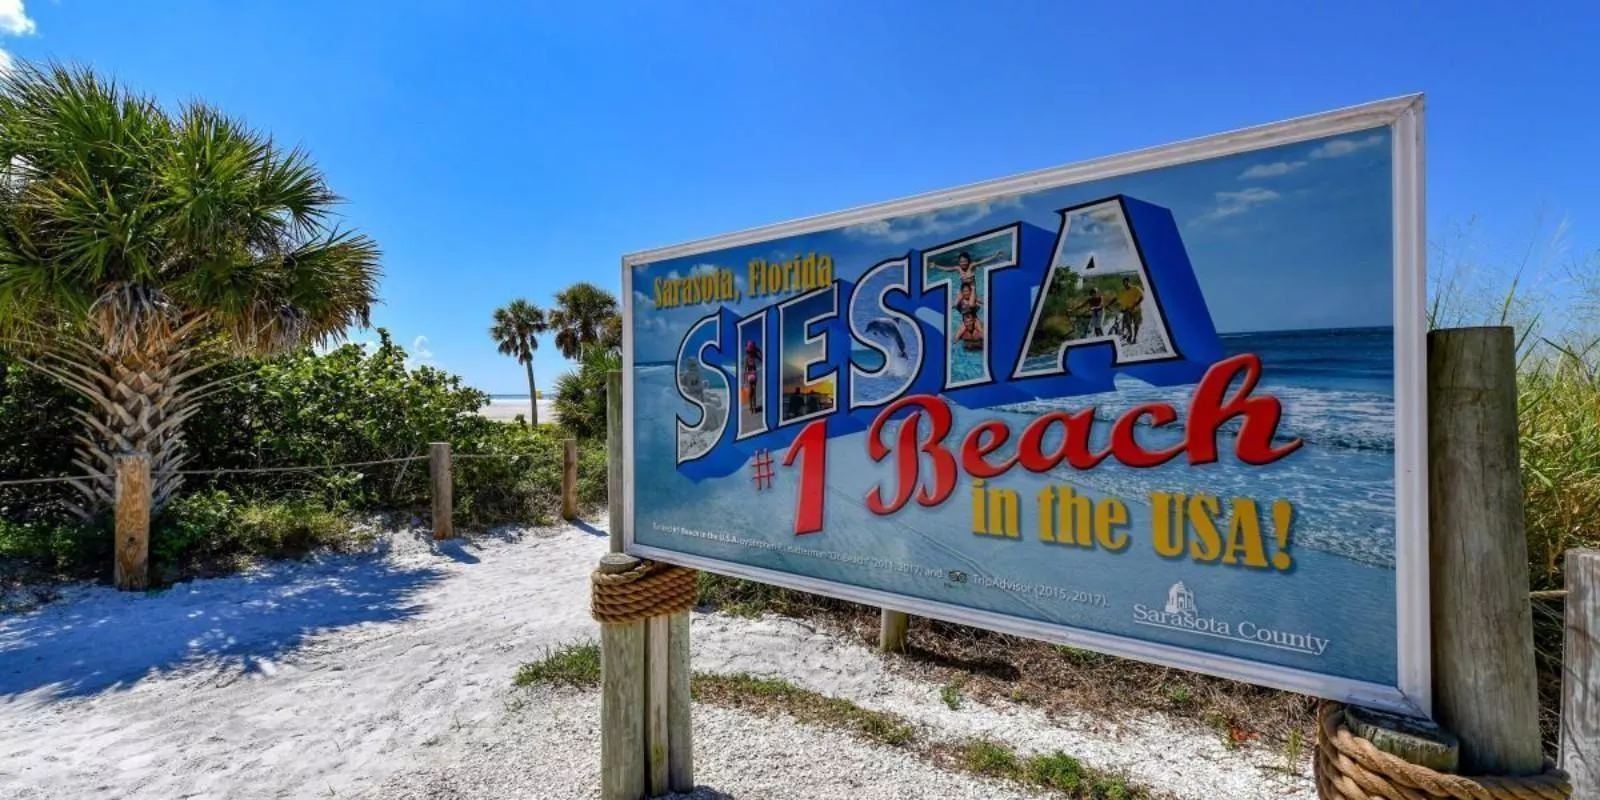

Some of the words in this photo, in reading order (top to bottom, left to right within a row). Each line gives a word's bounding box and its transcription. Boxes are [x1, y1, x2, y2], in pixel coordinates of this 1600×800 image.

[654, 268, 741, 309] Sarasota,
[748, 251, 833, 297] Florida
[675, 194, 1183, 466] SIESTA
[751, 418, 827, 536] #1
[865, 353, 1304, 516] Beach
[971, 478, 1022, 539] in
[1036, 485, 1130, 549] the
[1150, 490, 1294, 571] USA!
[973, 574, 1032, 593] TripAdvisor
[1033, 583, 1070, 600] (2015,
[1133, 603, 1231, 636] Sarasota
[1237, 620, 1331, 656] County
